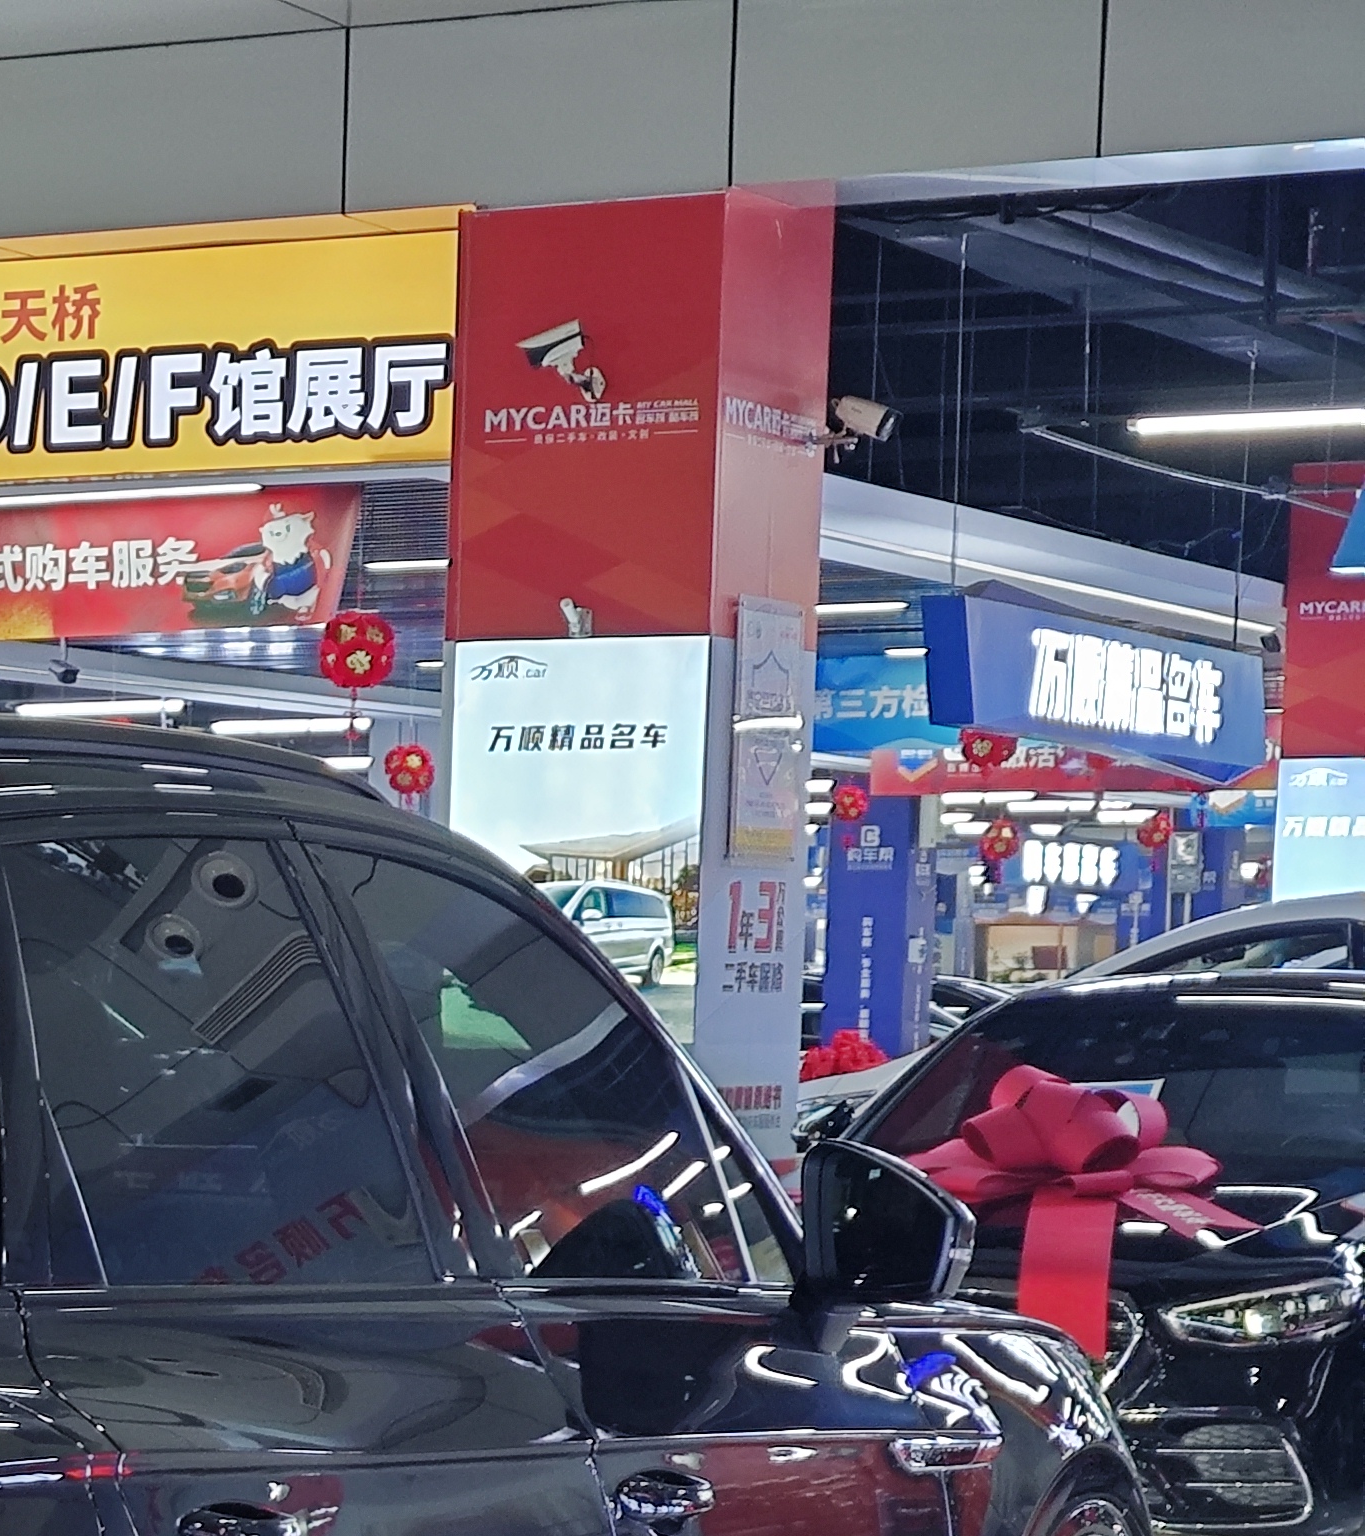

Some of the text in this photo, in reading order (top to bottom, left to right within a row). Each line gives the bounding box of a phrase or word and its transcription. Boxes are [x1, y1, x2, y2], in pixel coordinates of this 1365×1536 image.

[487, 723, 669, 752] 万顺精品名车
